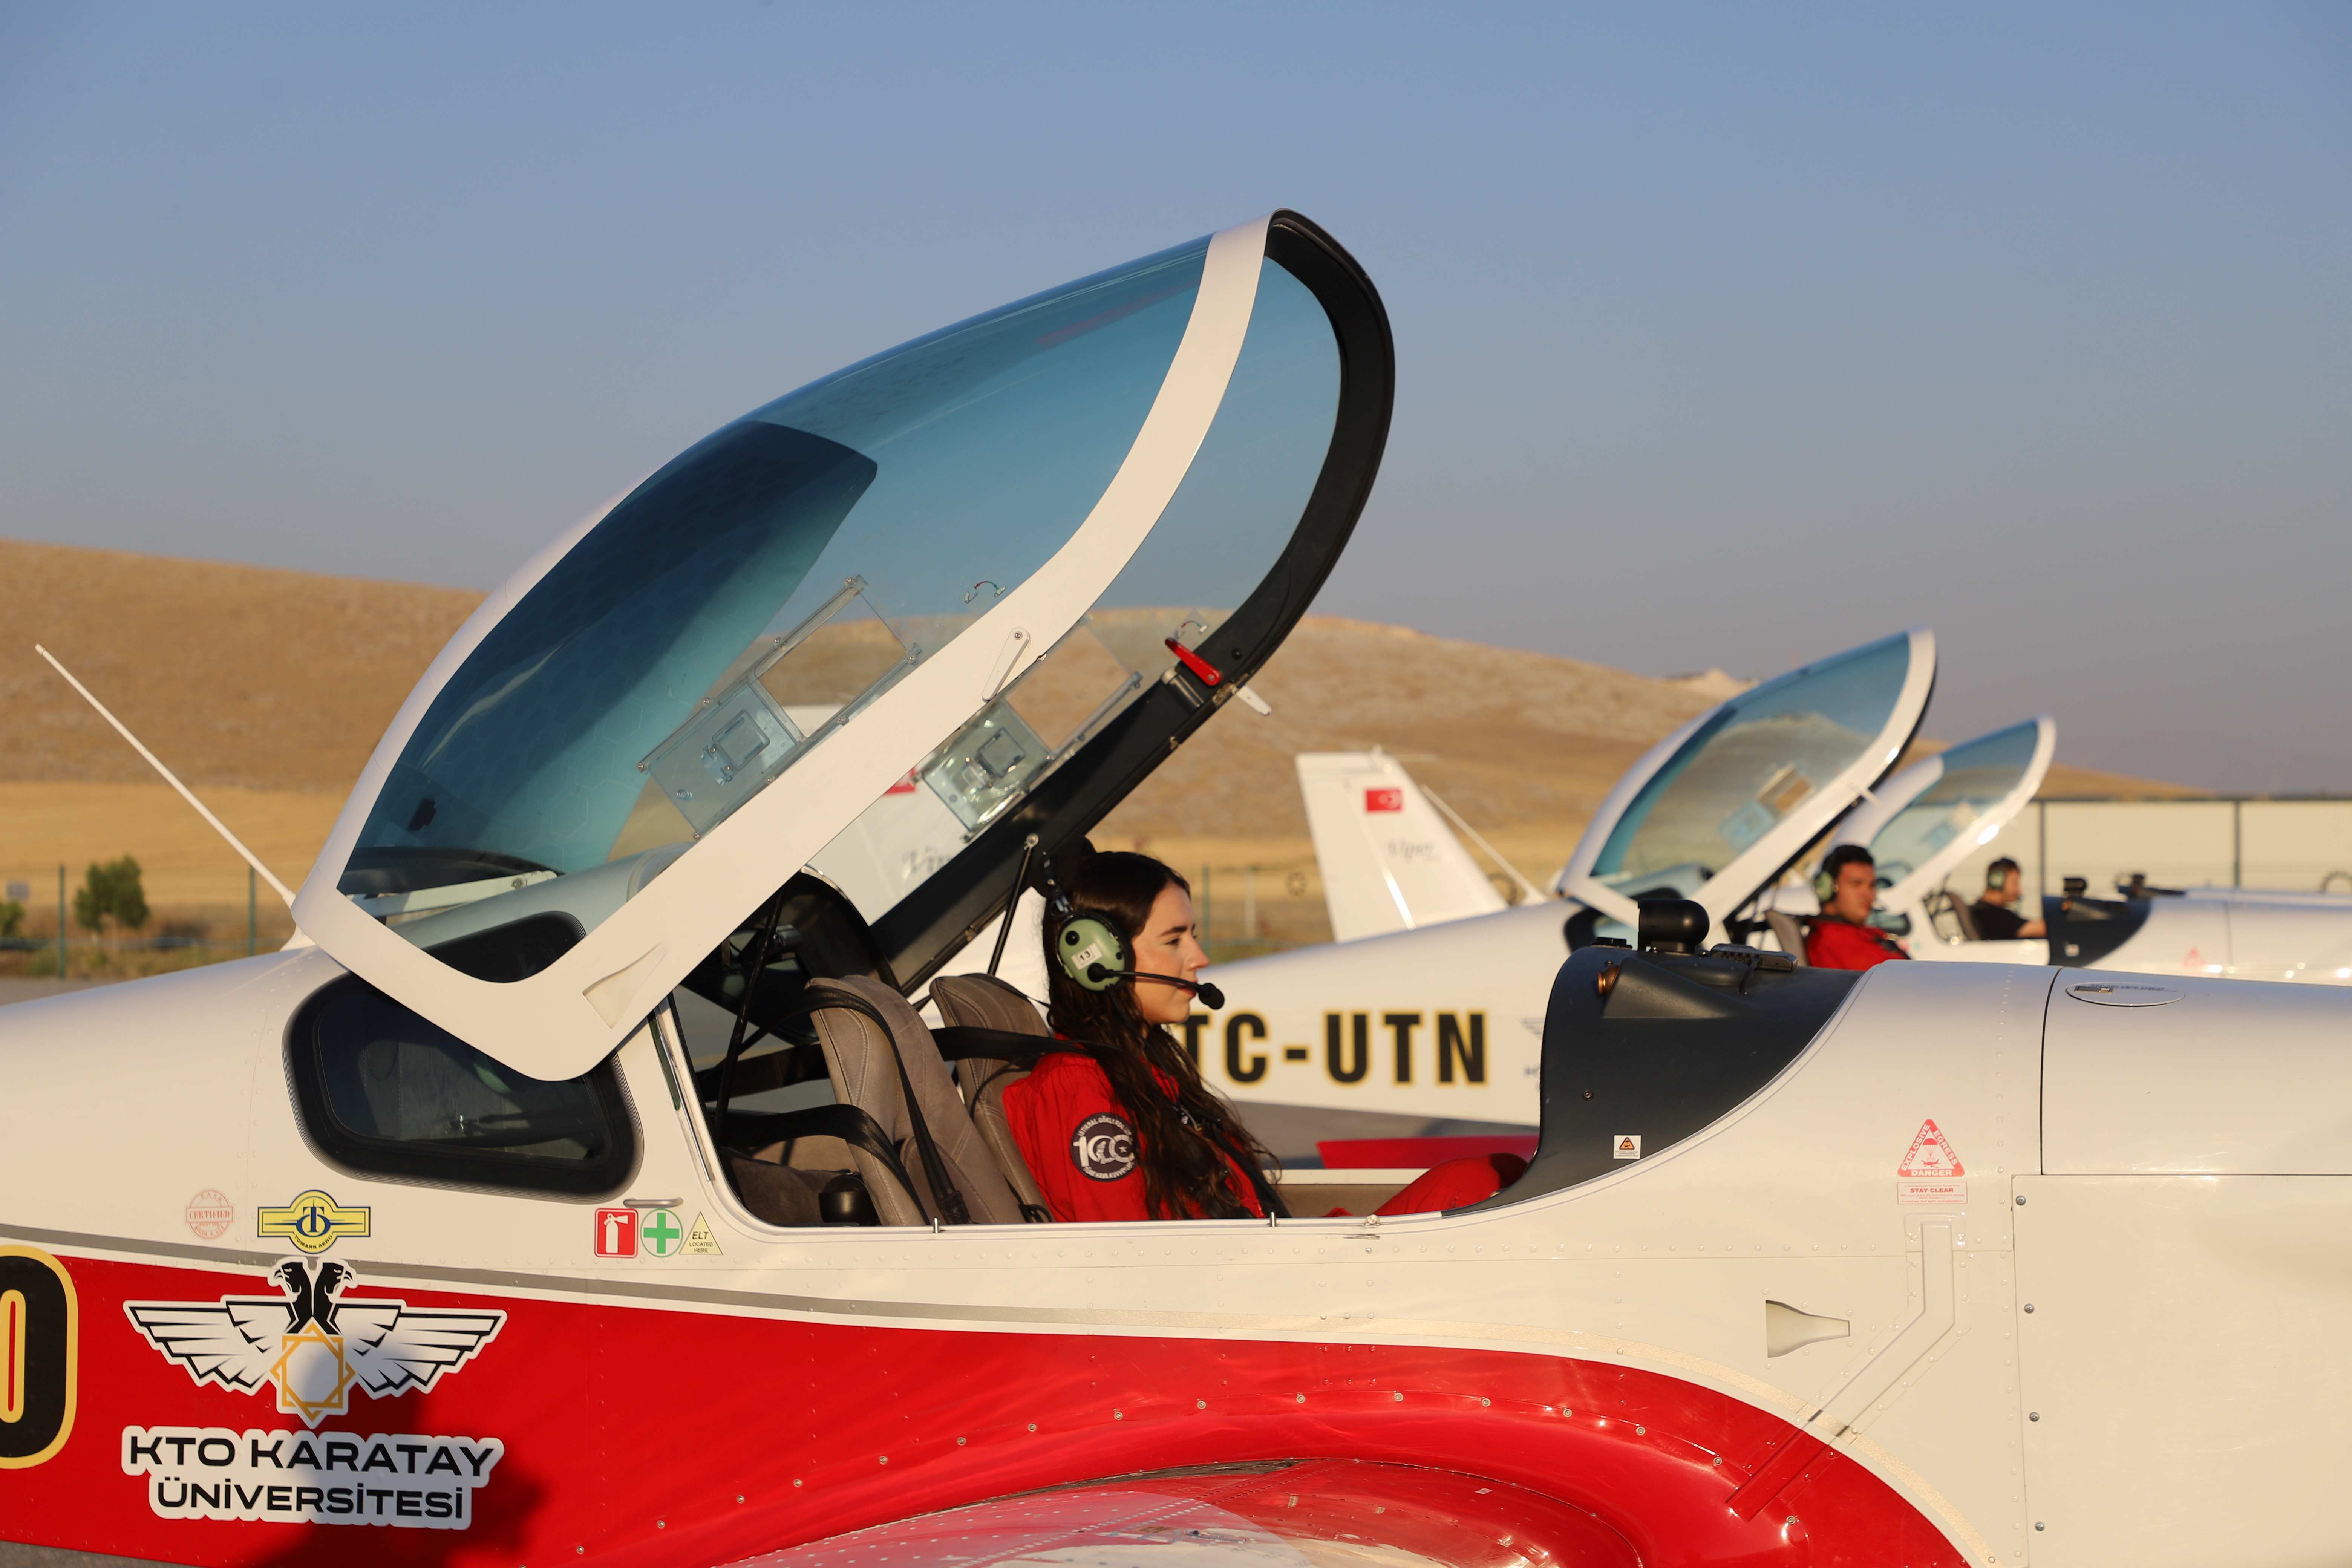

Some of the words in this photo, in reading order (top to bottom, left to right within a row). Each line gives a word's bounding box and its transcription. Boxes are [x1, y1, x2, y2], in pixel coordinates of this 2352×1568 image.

[1080, 951, 1090, 960] 13
[1901, 1123, 1930, 1171] EXPLOSIVE
[1933, 1130, 1958, 1165] EGRESS
[189, 1210, 230, 1219] CERTIFIED
[295, 1234, 317, 1249] TOMARK
[319, 1234, 332, 1248] AERO
[692, 1231, 709, 1239] ELT
[130, 1436, 236, 1466] KTO
[251, 1439, 495, 1476] KARATAY
[158, 1476, 462, 1518] ÜNİVERSİTESİ
